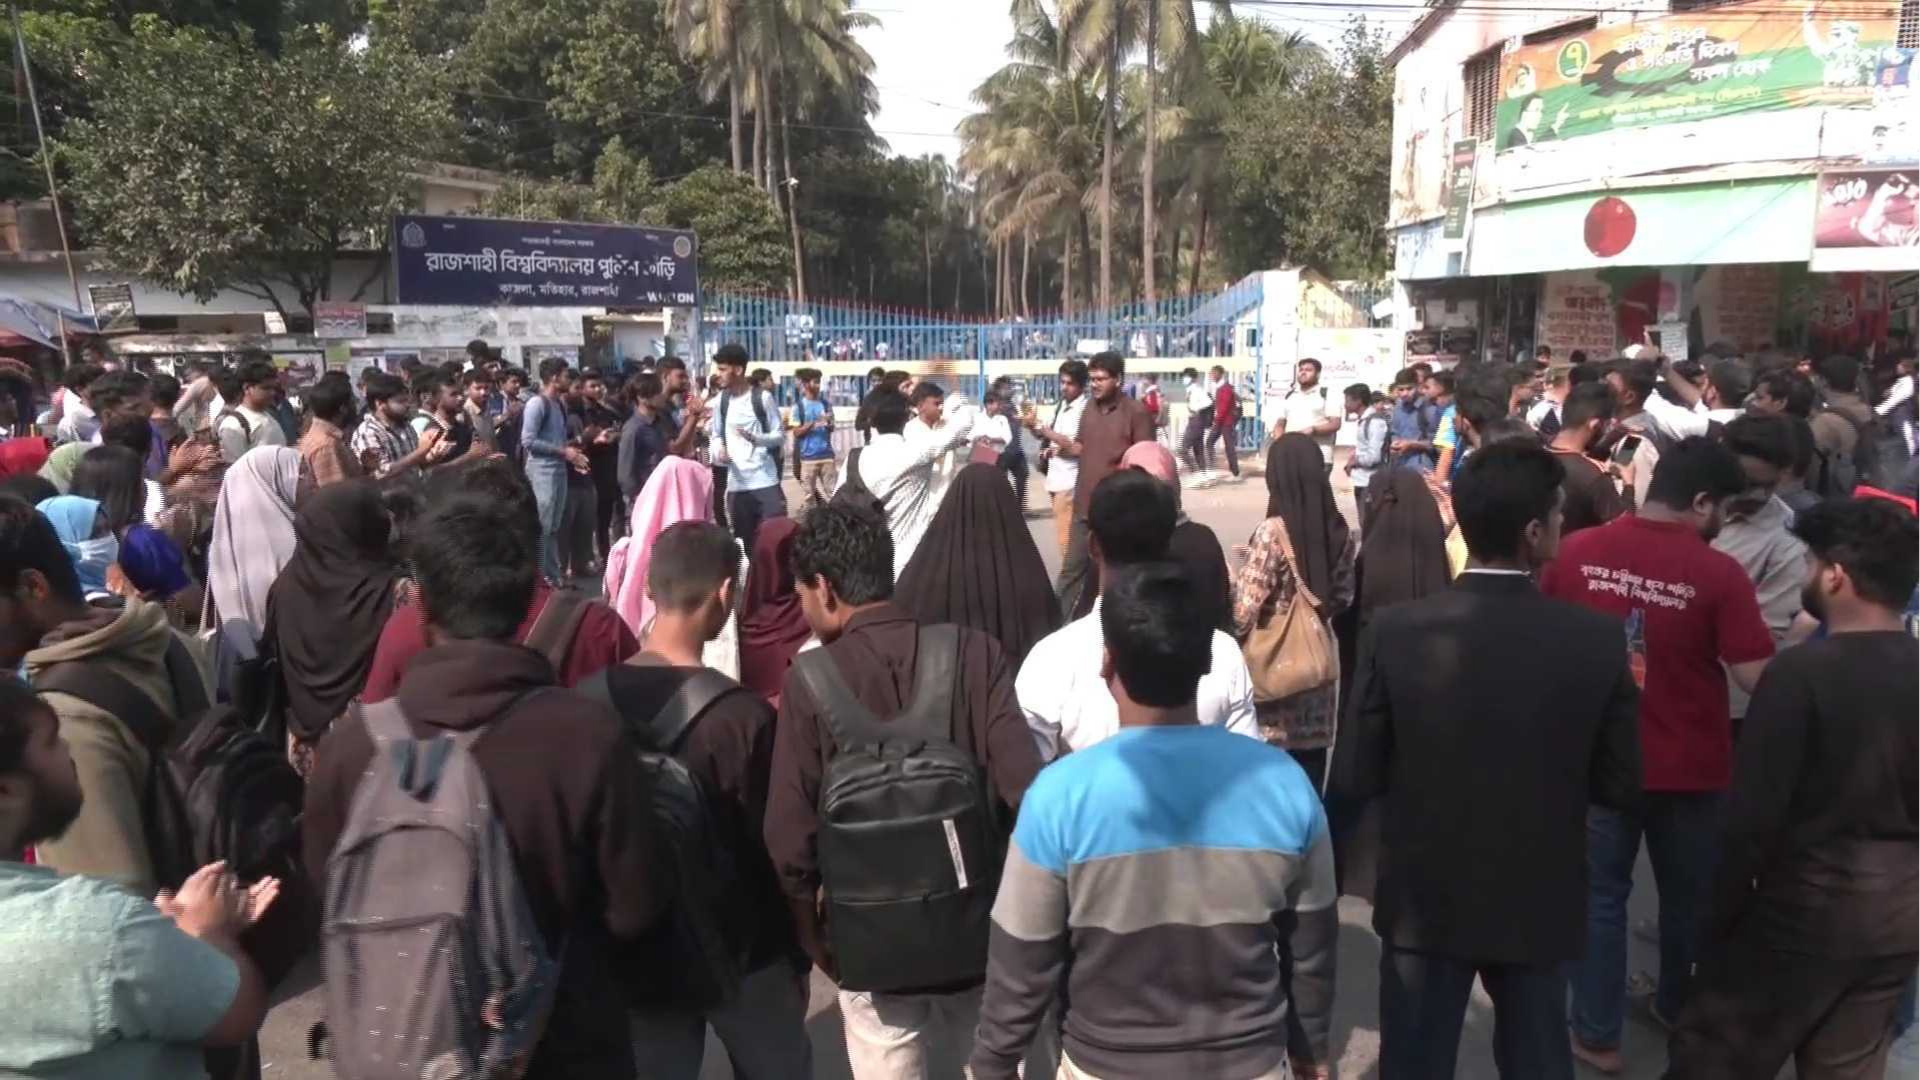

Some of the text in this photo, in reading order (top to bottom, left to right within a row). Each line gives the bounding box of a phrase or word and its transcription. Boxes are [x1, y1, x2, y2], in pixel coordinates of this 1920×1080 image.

[1566, 43, 1583, 68] ৭
[425, 247, 497, 273] রাজশাহী
[500, 249, 595, 276] বিশ্ববিদ্যালয়
[647, 291, 695, 304] WON
